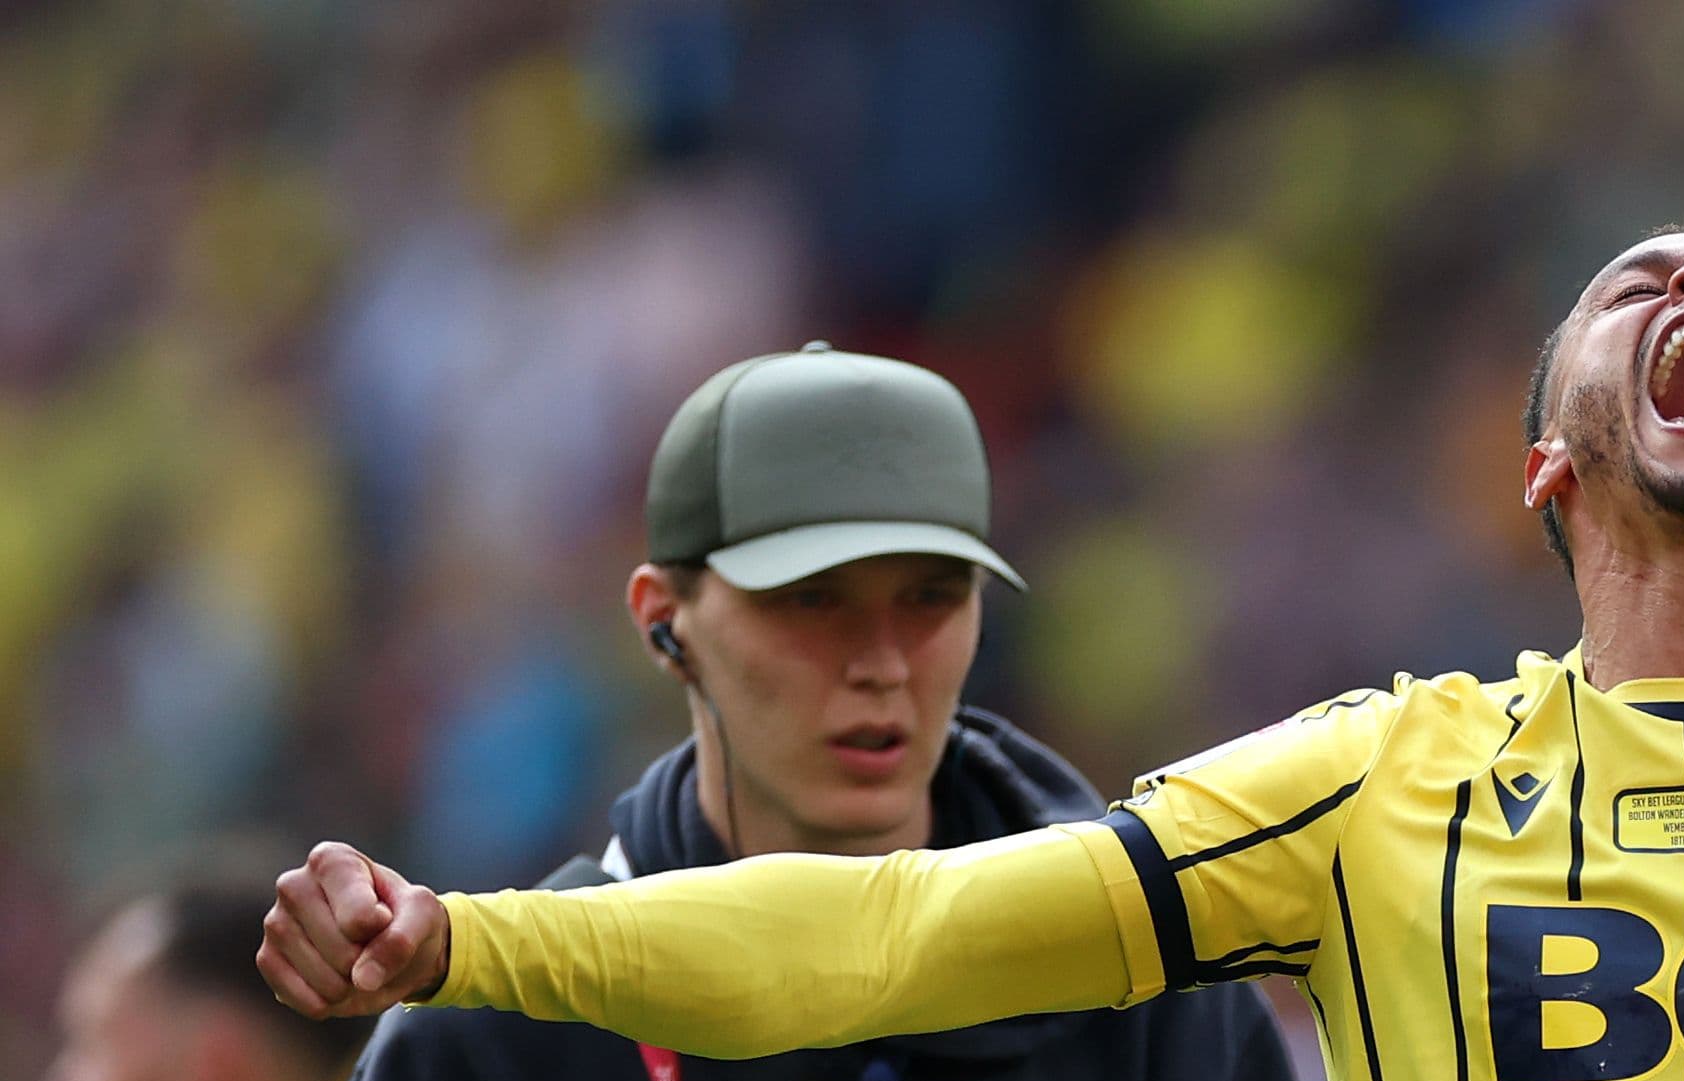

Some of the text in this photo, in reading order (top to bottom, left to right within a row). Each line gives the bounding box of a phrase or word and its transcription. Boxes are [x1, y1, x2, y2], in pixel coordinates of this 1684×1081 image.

[1632, 798, 1646, 809] SKY
[1648, 796, 1660, 807] BET
[1629, 810, 1656, 821] BOLTON
